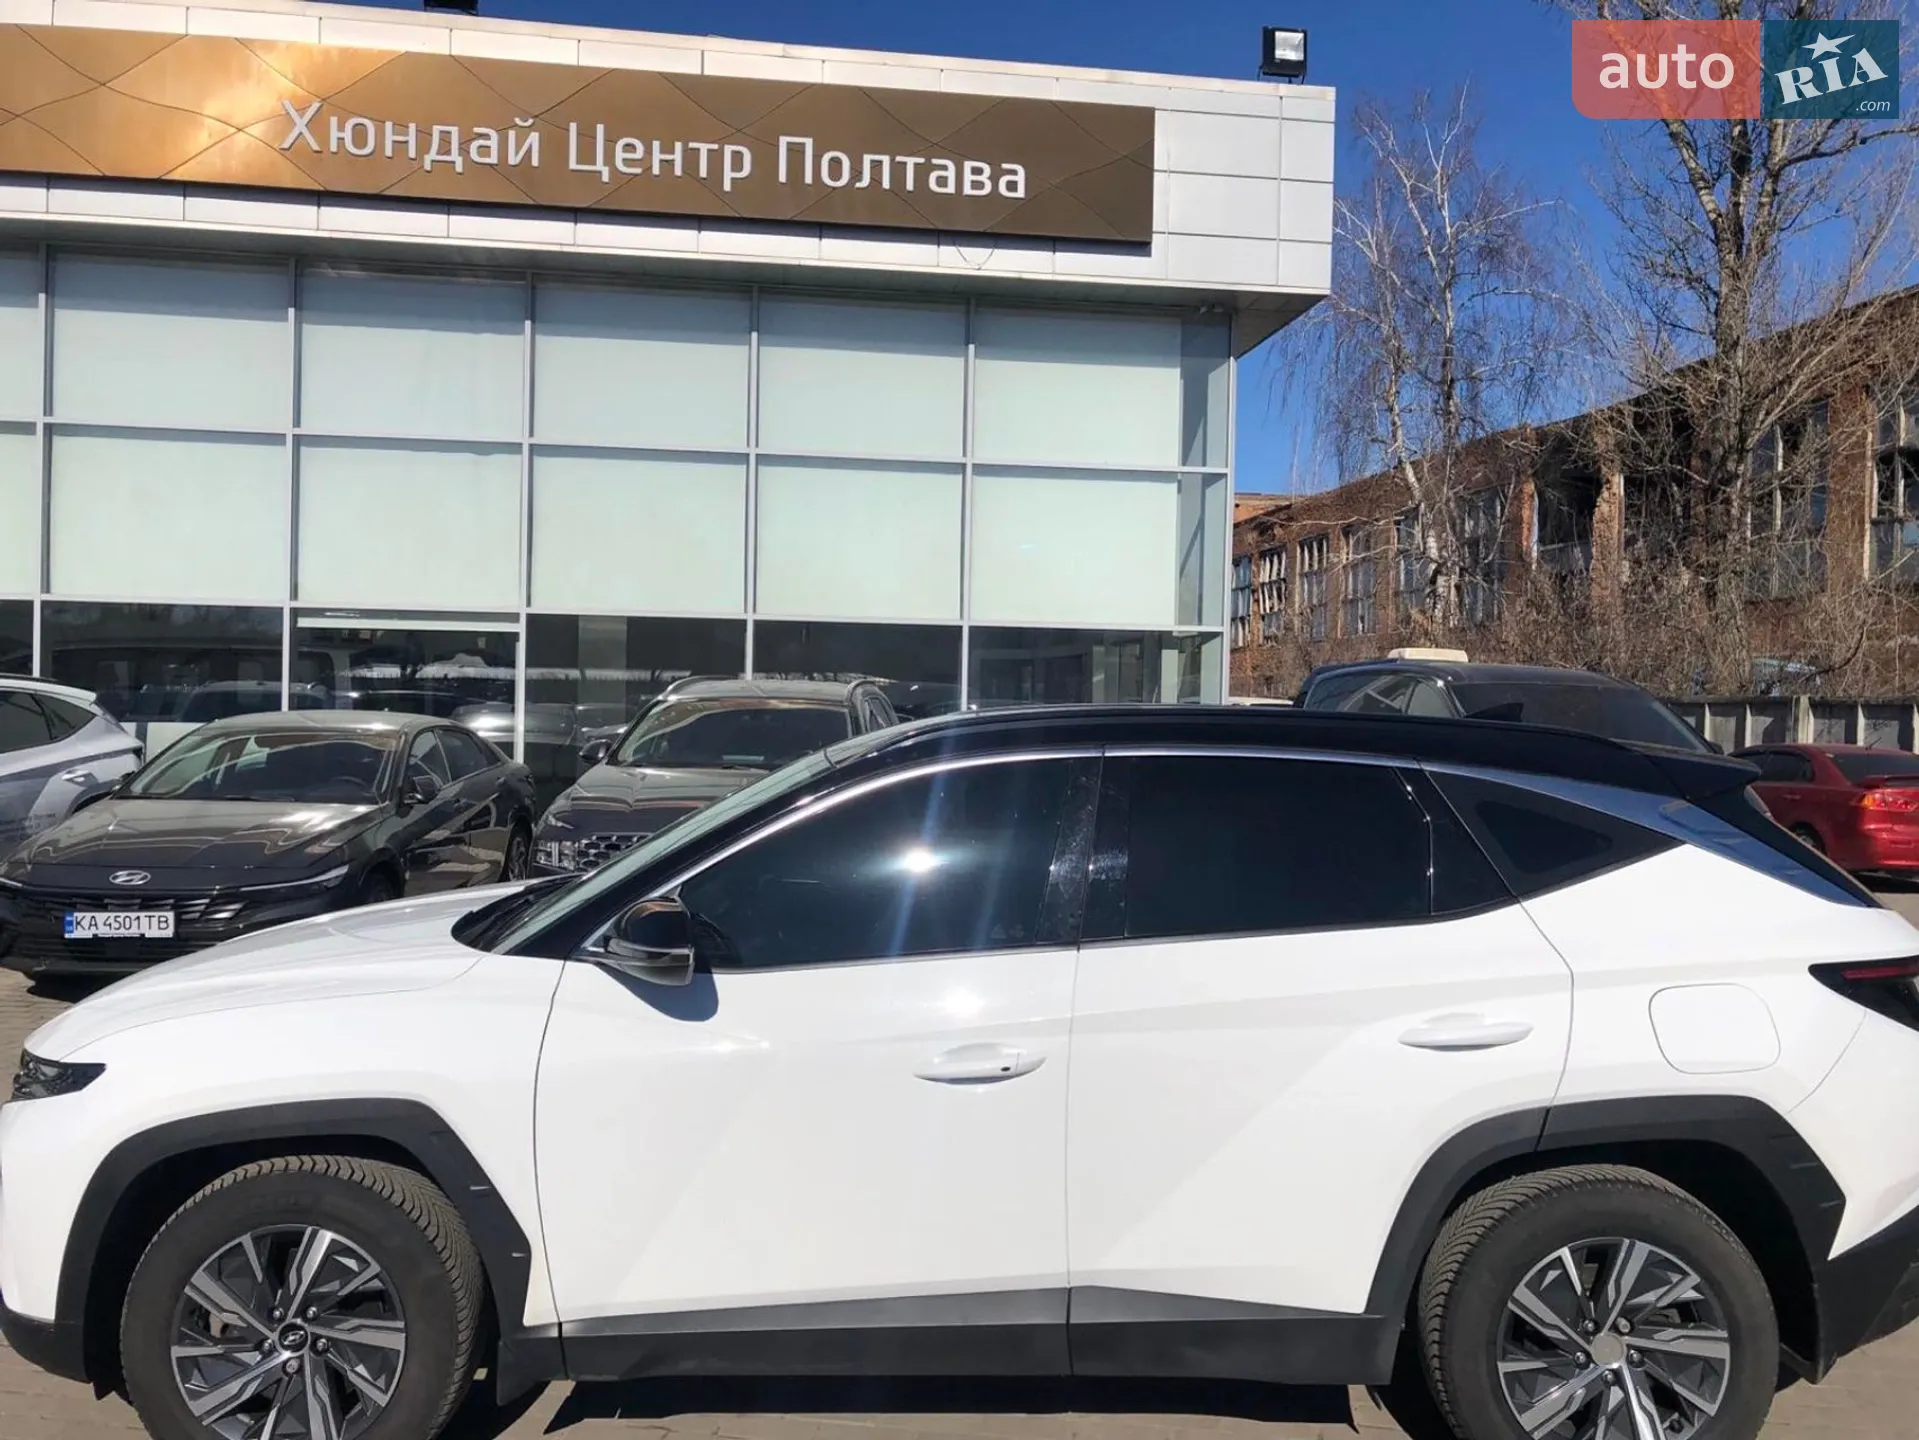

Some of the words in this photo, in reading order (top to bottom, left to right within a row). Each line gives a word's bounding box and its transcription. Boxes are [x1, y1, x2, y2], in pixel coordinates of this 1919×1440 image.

[279, 100, 540, 173] Хюндай
[569, 122, 752, 192] Центр
[778, 135, 1026, 199] Полтава
